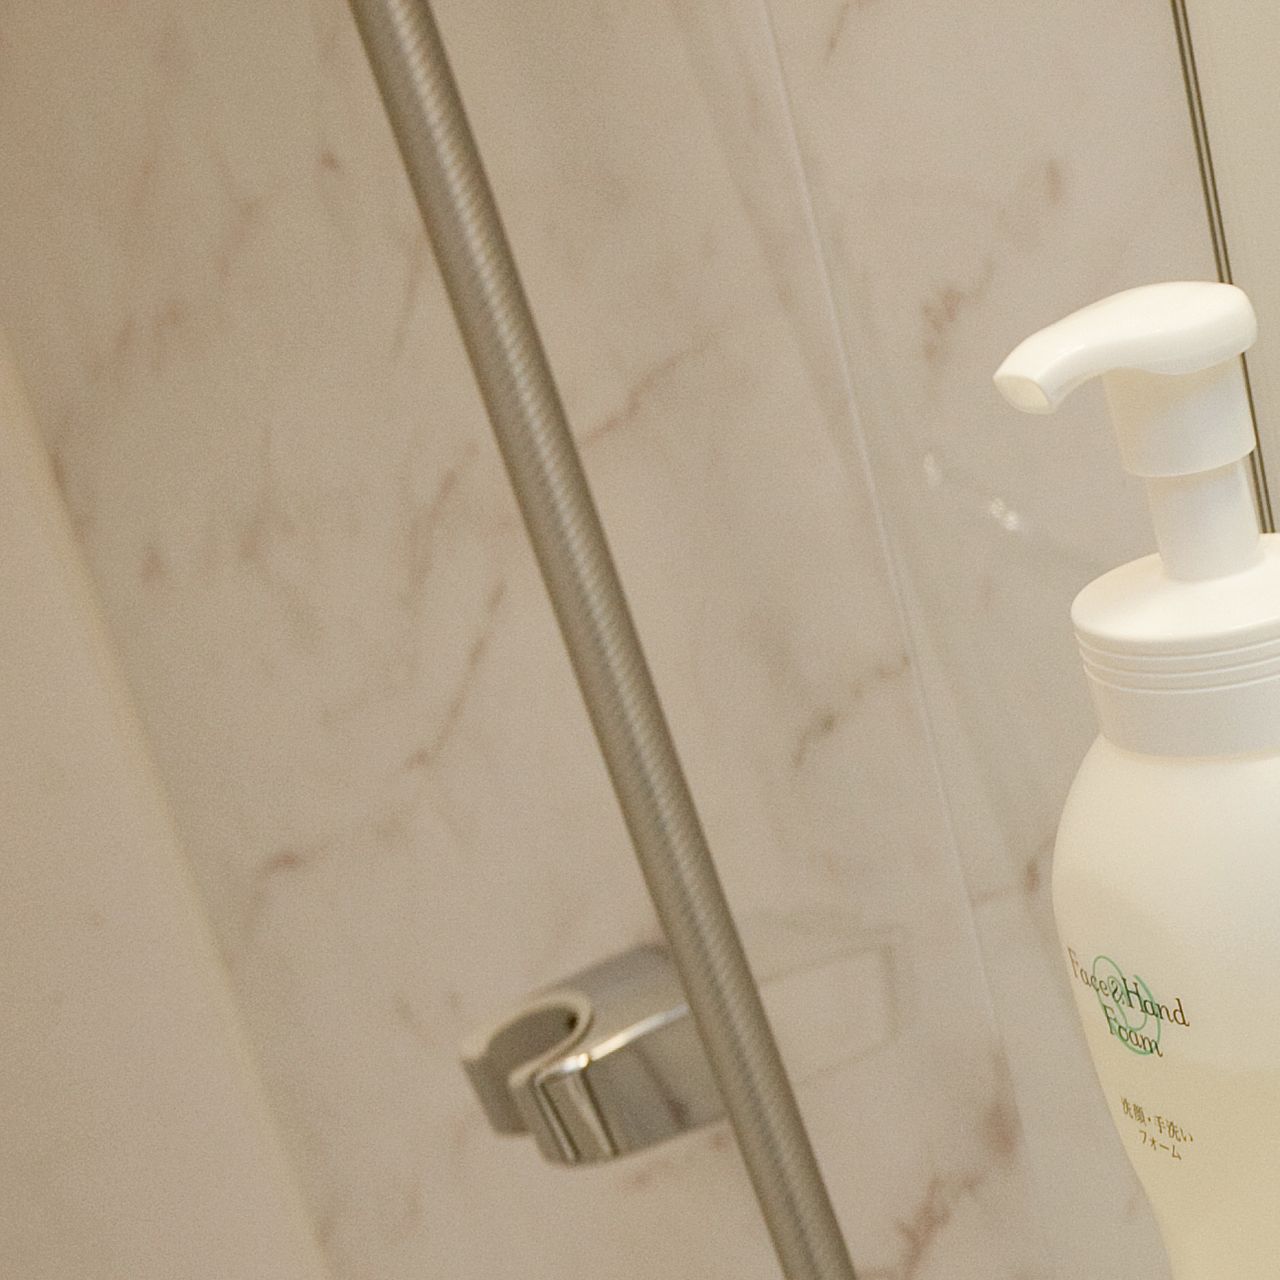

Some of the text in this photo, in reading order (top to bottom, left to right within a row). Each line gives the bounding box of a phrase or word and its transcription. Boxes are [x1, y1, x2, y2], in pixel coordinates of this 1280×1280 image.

[1103, 1004, 1163, 1057] Foam
[1139, 1129, 1181, 1160] フォーム
